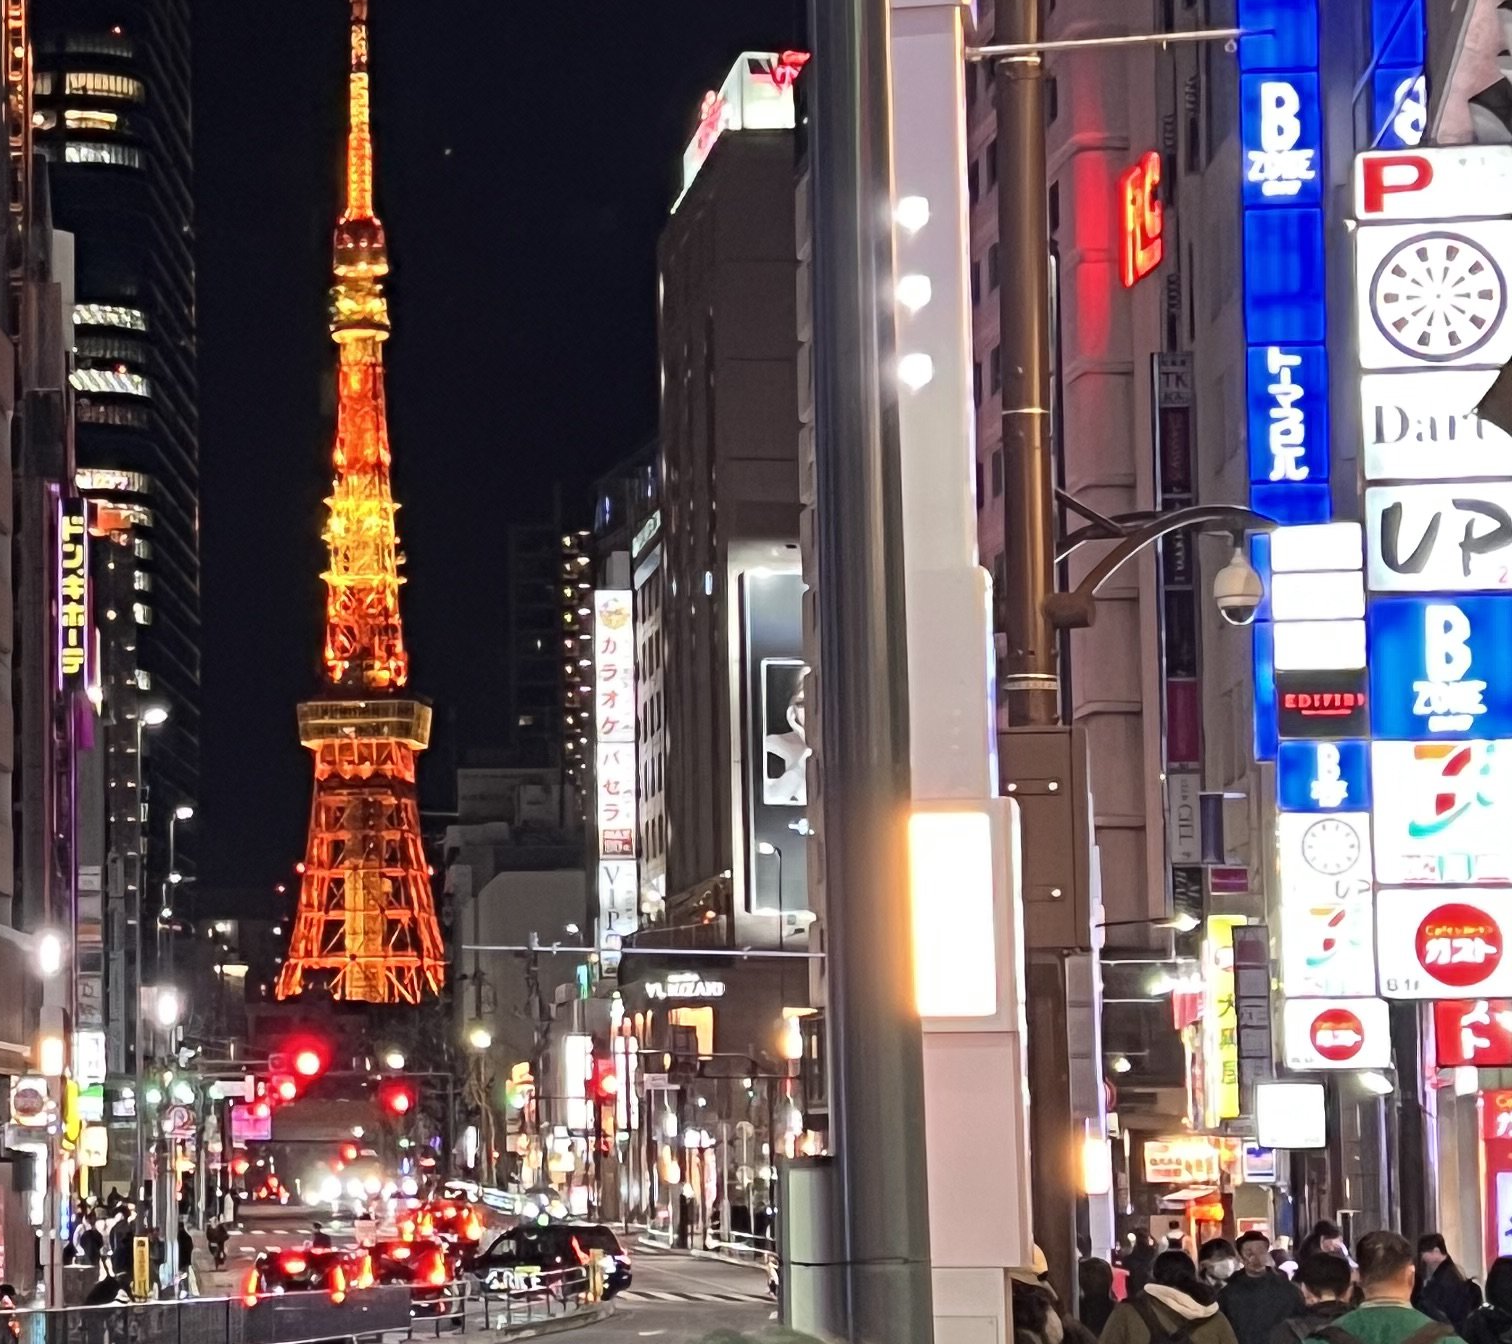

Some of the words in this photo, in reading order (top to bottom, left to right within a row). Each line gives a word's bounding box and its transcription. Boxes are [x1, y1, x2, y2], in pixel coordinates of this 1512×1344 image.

[1261, 82, 1301, 152] B
[1363, 156, 1433, 213] P
[1425, 605, 1473, 683] B
[600, 637, 620, 735] カラオケ
[604, 865, 621, 932] VIP
